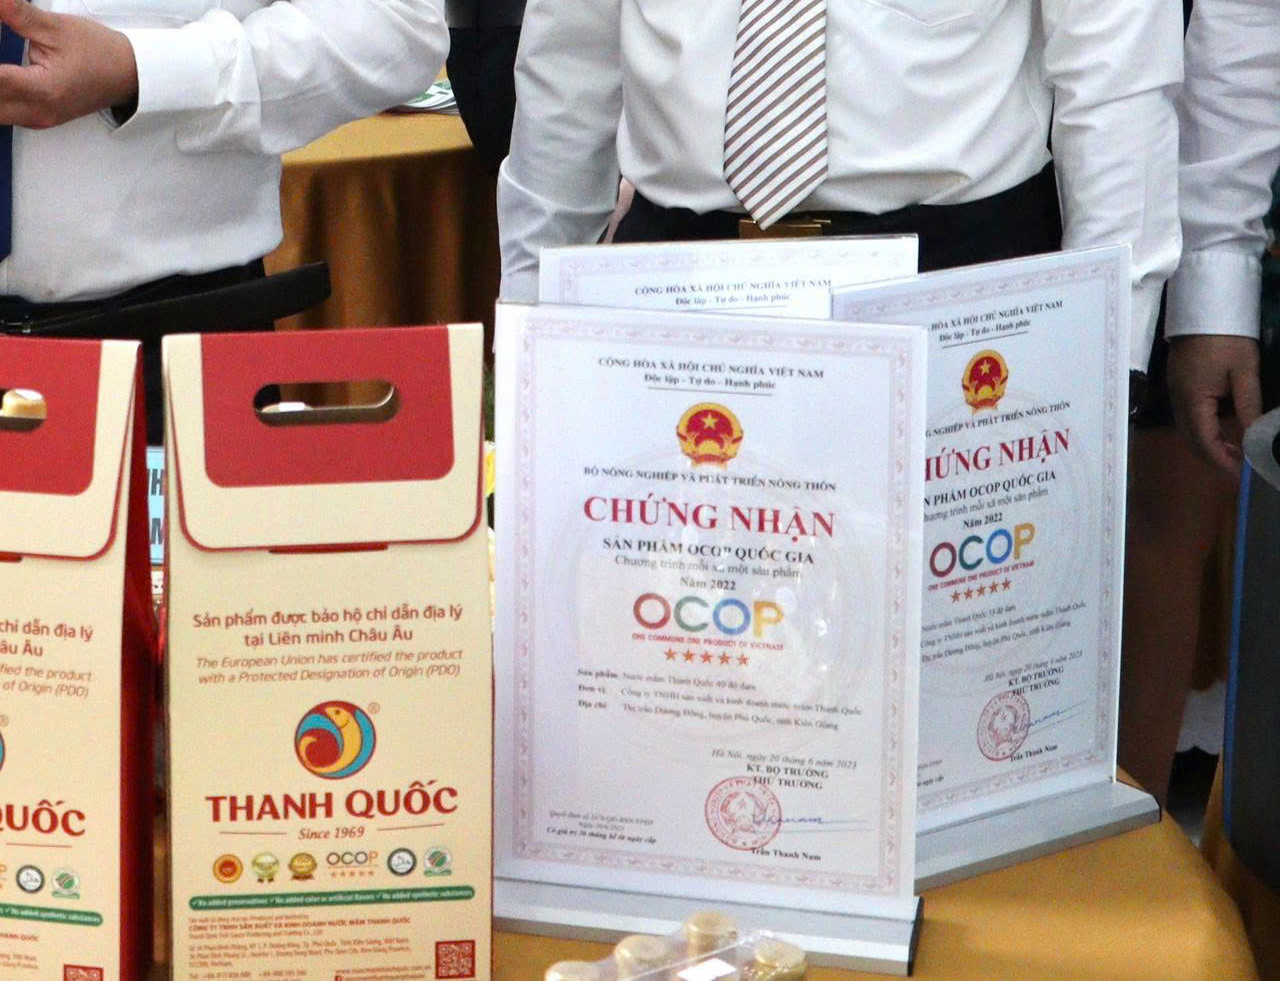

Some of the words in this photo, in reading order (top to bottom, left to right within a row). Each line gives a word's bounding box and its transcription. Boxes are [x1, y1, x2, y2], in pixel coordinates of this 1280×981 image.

[598, 356, 629, 366] CỘNG
[633, 359, 656, 368] HÒA
[660, 360, 674, 369] XÃ
[678, 361, 699, 371] HỘI
[729, 365, 764, 375] NGHĨA
[768, 366, 793, 376] VIỆT
[798, 369, 823, 378] NAM
[999, 428, 1069, 465] NHẬN
[934, 489, 966, 505] PHẨM
[969, 482, 1000, 497] OCOP
[1002, 474, 1033, 492] QUỐC
[1036, 470, 1055, 482] GIA
[584, 493, 717, 529] CHỨNG
[730, 506, 836, 542] NHẬN
[964, 519, 981, 527] Năm
[984, 512, 1002, 524] 2022
[603, 538, 631, 549] SẢN
[637, 540, 682, 553] PHẨM
[785, 551, 813, 564] GIA
[930, 522, 1036, 578] OCOP
[680, 577, 706, 587] Năm
[710, 579, 735, 591] 2022
[192, 612, 220, 627] Sản
[224, 608, 267, 629] phẩm
[271, 611, 306, 626] được
[311, 608, 339, 623] bảo
[343, 607, 362, 624] hộ
[366, 605, 386, 620] chỉ
[391, 603, 419, 620] dẫn
[423, 605, 445, 621] địa
[449, 604, 462, 621] lý
[633, 592, 783, 637] OCOP
[22, 618, 49, 635] dẫn
[53, 623, 76, 640] địa
[80, 625, 93, 642] lý
[244, 633, 263, 646] tại
[269, 631, 300, 645] Liên
[306, 629, 344, 643] minh
[348, 627, 387, 642] Châu
[392, 624, 412, 640] Âu
[22, 641, 43, 656] Âu
[196, 657, 218, 668] The
[220, 656, 277, 669] European
[280, 654, 314, 666] Union
[317, 654, 338, 663] has
[341, 651, 392, 663] certified
[395, 650, 414, 661] the
[416, 649, 463, 662] product
[24, 666, 44, 677] the
[46, 669, 91, 681] product
[198, 673, 225, 684] with
[227, 674, 235, 682] a
[238, 670, 298, 682] Protected
[300, 667, 370, 682] Designation
[372, 666, 386, 678] of
[388, 665, 423, 678] Origin
[425, 663, 460, 677] (PDO)
[2, 680, 15, 690] of
[18, 681, 52, 695] Origin
[55, 684, 88, 698] (PDO)
[205, 792, 332, 822] THANH
[345, 780, 457, 818] QUỐC
[298, 828, 330, 839] Since
[334, 826, 364, 838] 1969
[326, 851, 377, 866] OCOP
